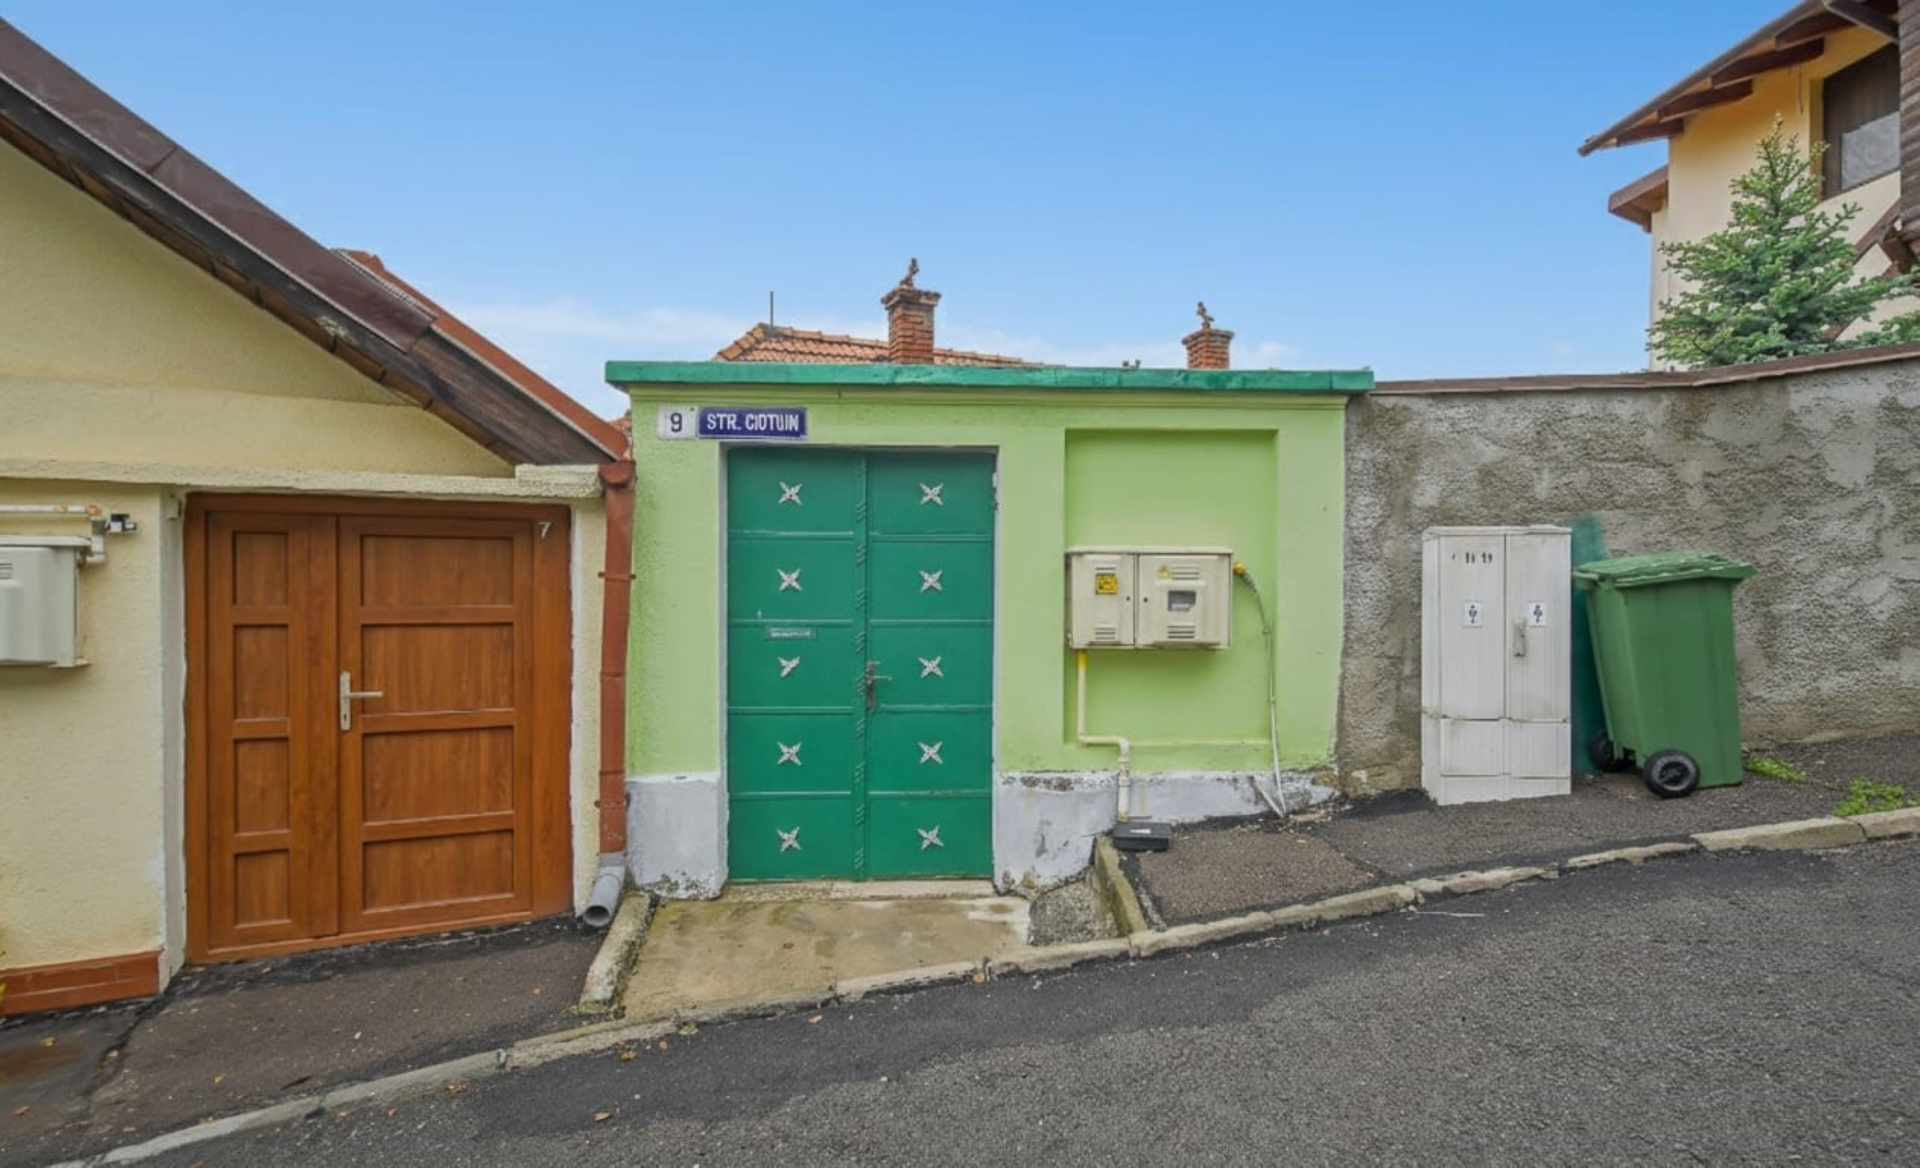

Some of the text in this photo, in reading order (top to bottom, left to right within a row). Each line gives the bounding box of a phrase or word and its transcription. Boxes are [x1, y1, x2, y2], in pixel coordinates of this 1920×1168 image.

[670, 412, 683, 433] 9
[707, 413, 742, 430] STR.
[538, 521, 552, 539] 7
